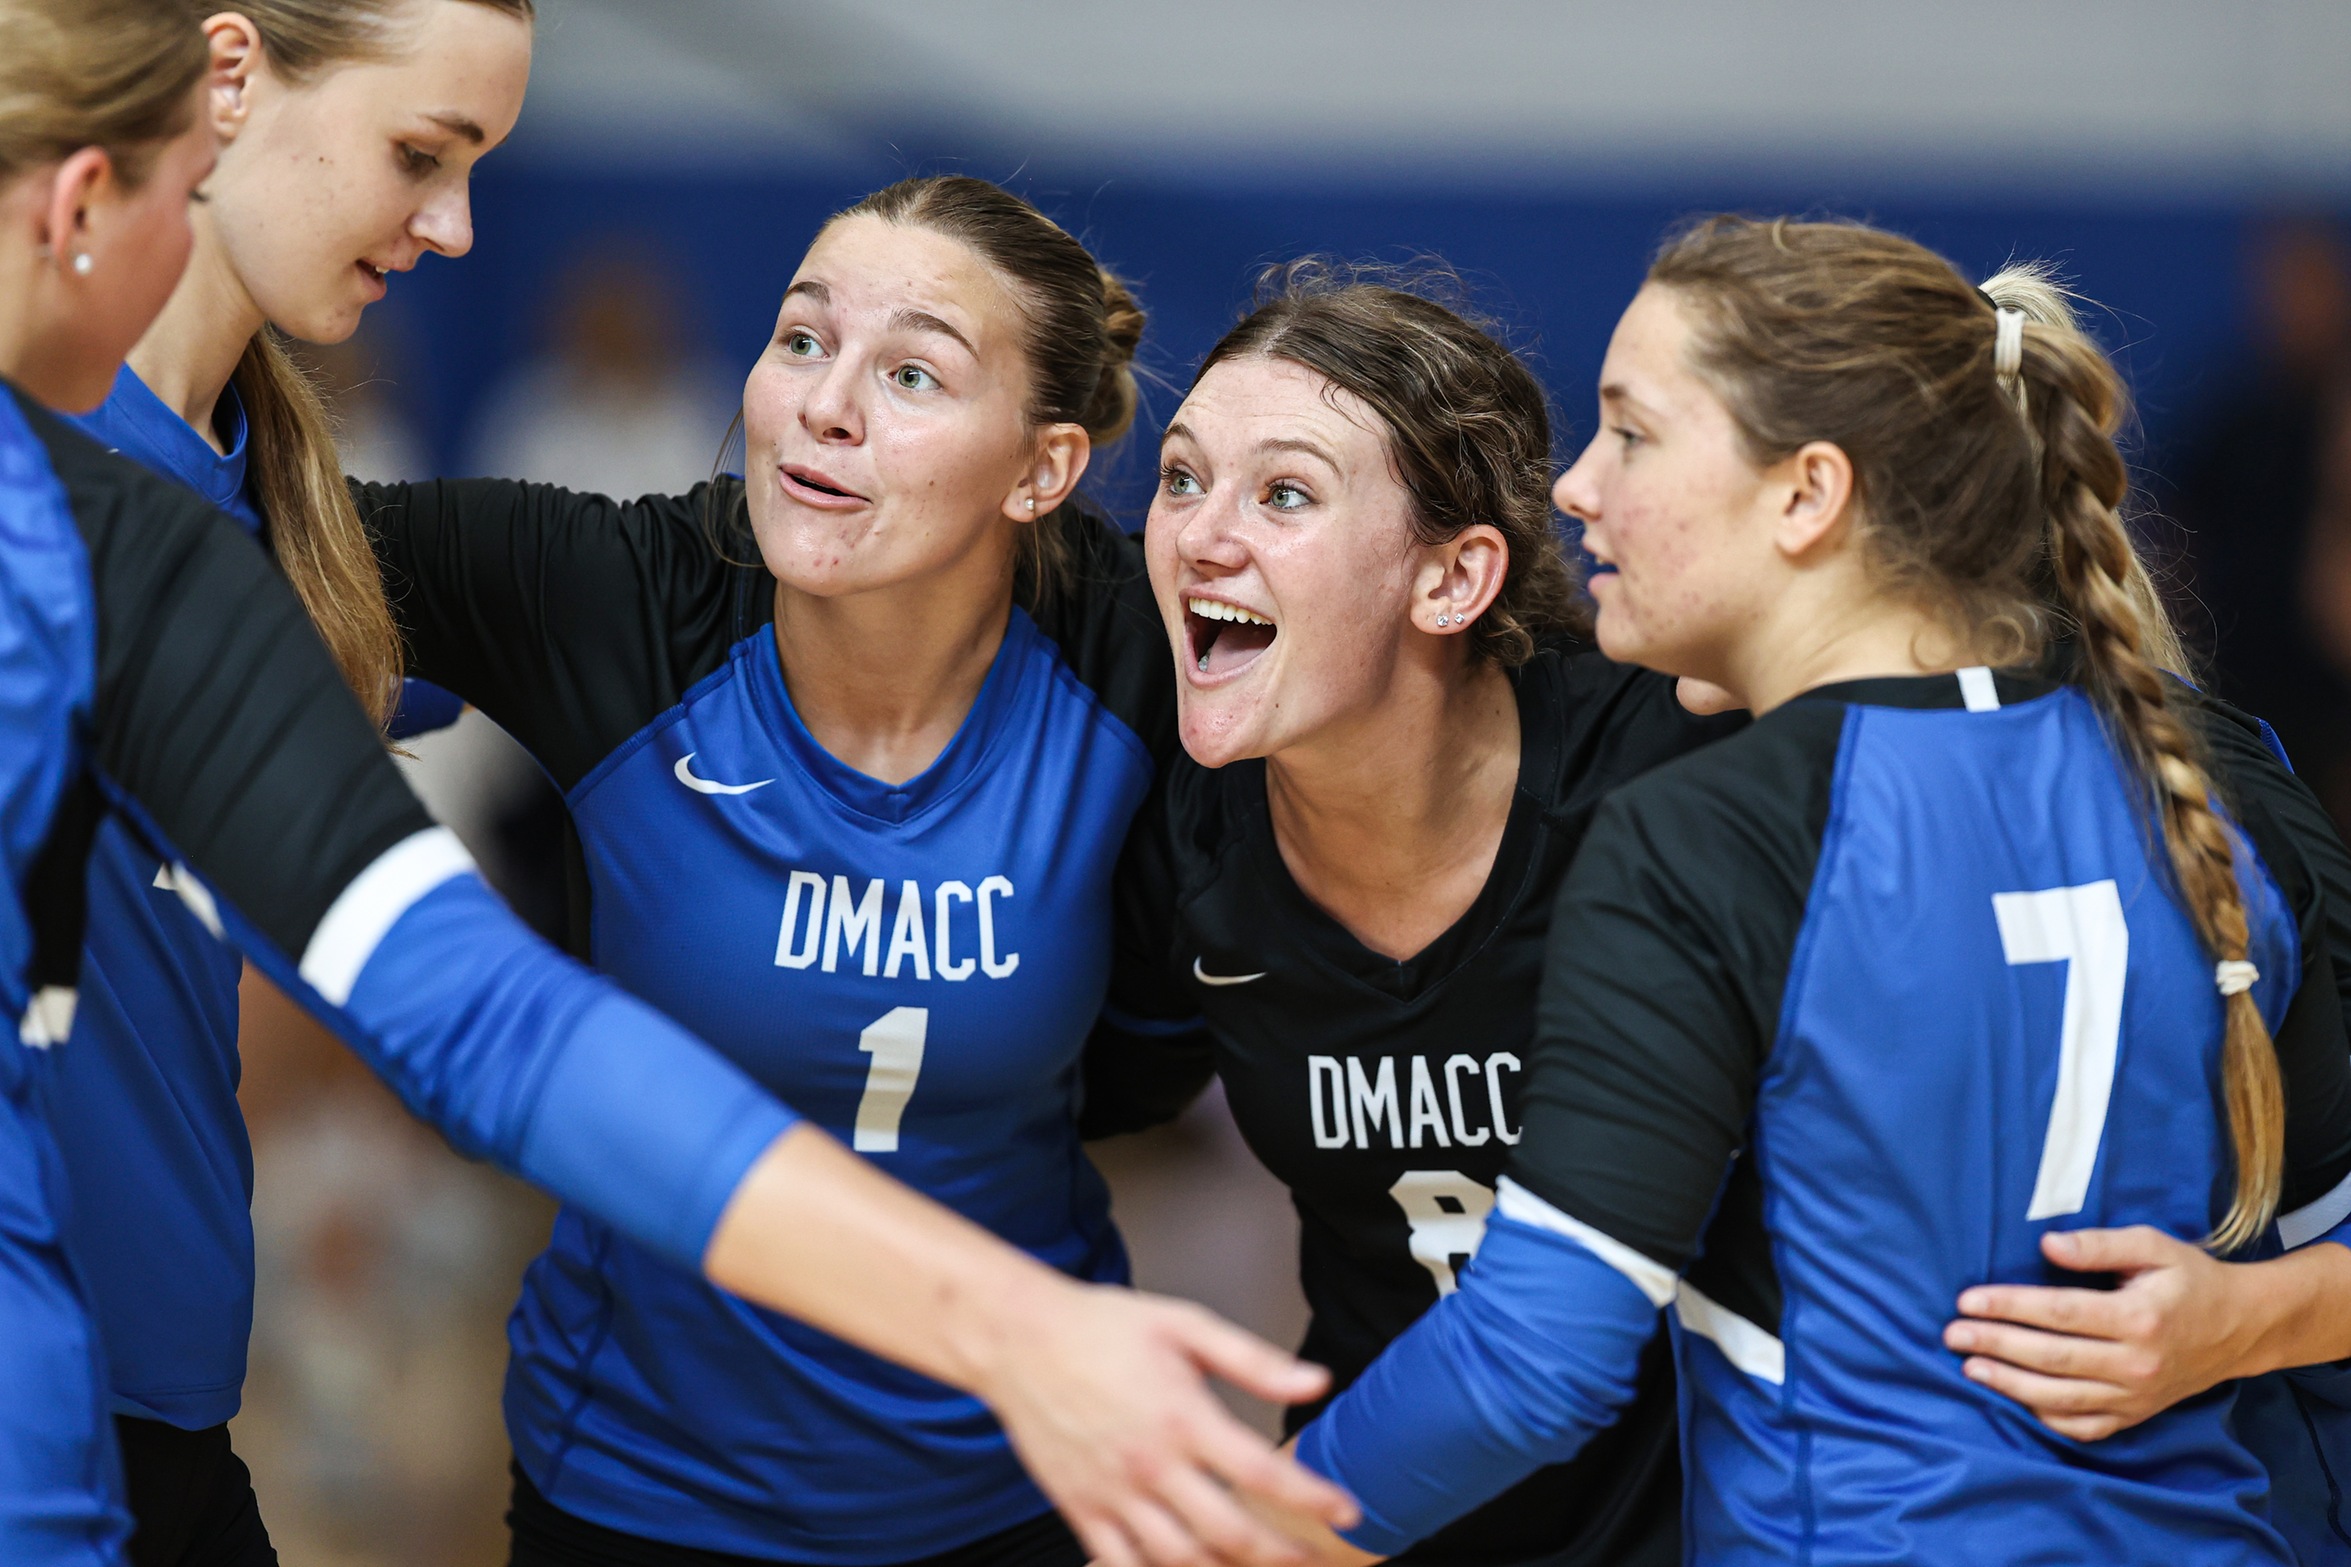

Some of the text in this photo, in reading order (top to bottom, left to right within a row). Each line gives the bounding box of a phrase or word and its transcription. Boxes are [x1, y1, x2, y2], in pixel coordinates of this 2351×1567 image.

[774, 870, 1020, 981] DMACC
[853, 1006, 929, 1152] 1
[1308, 1052, 1523, 1149] DMACC
[1991, 879, 2129, 1221] 7
